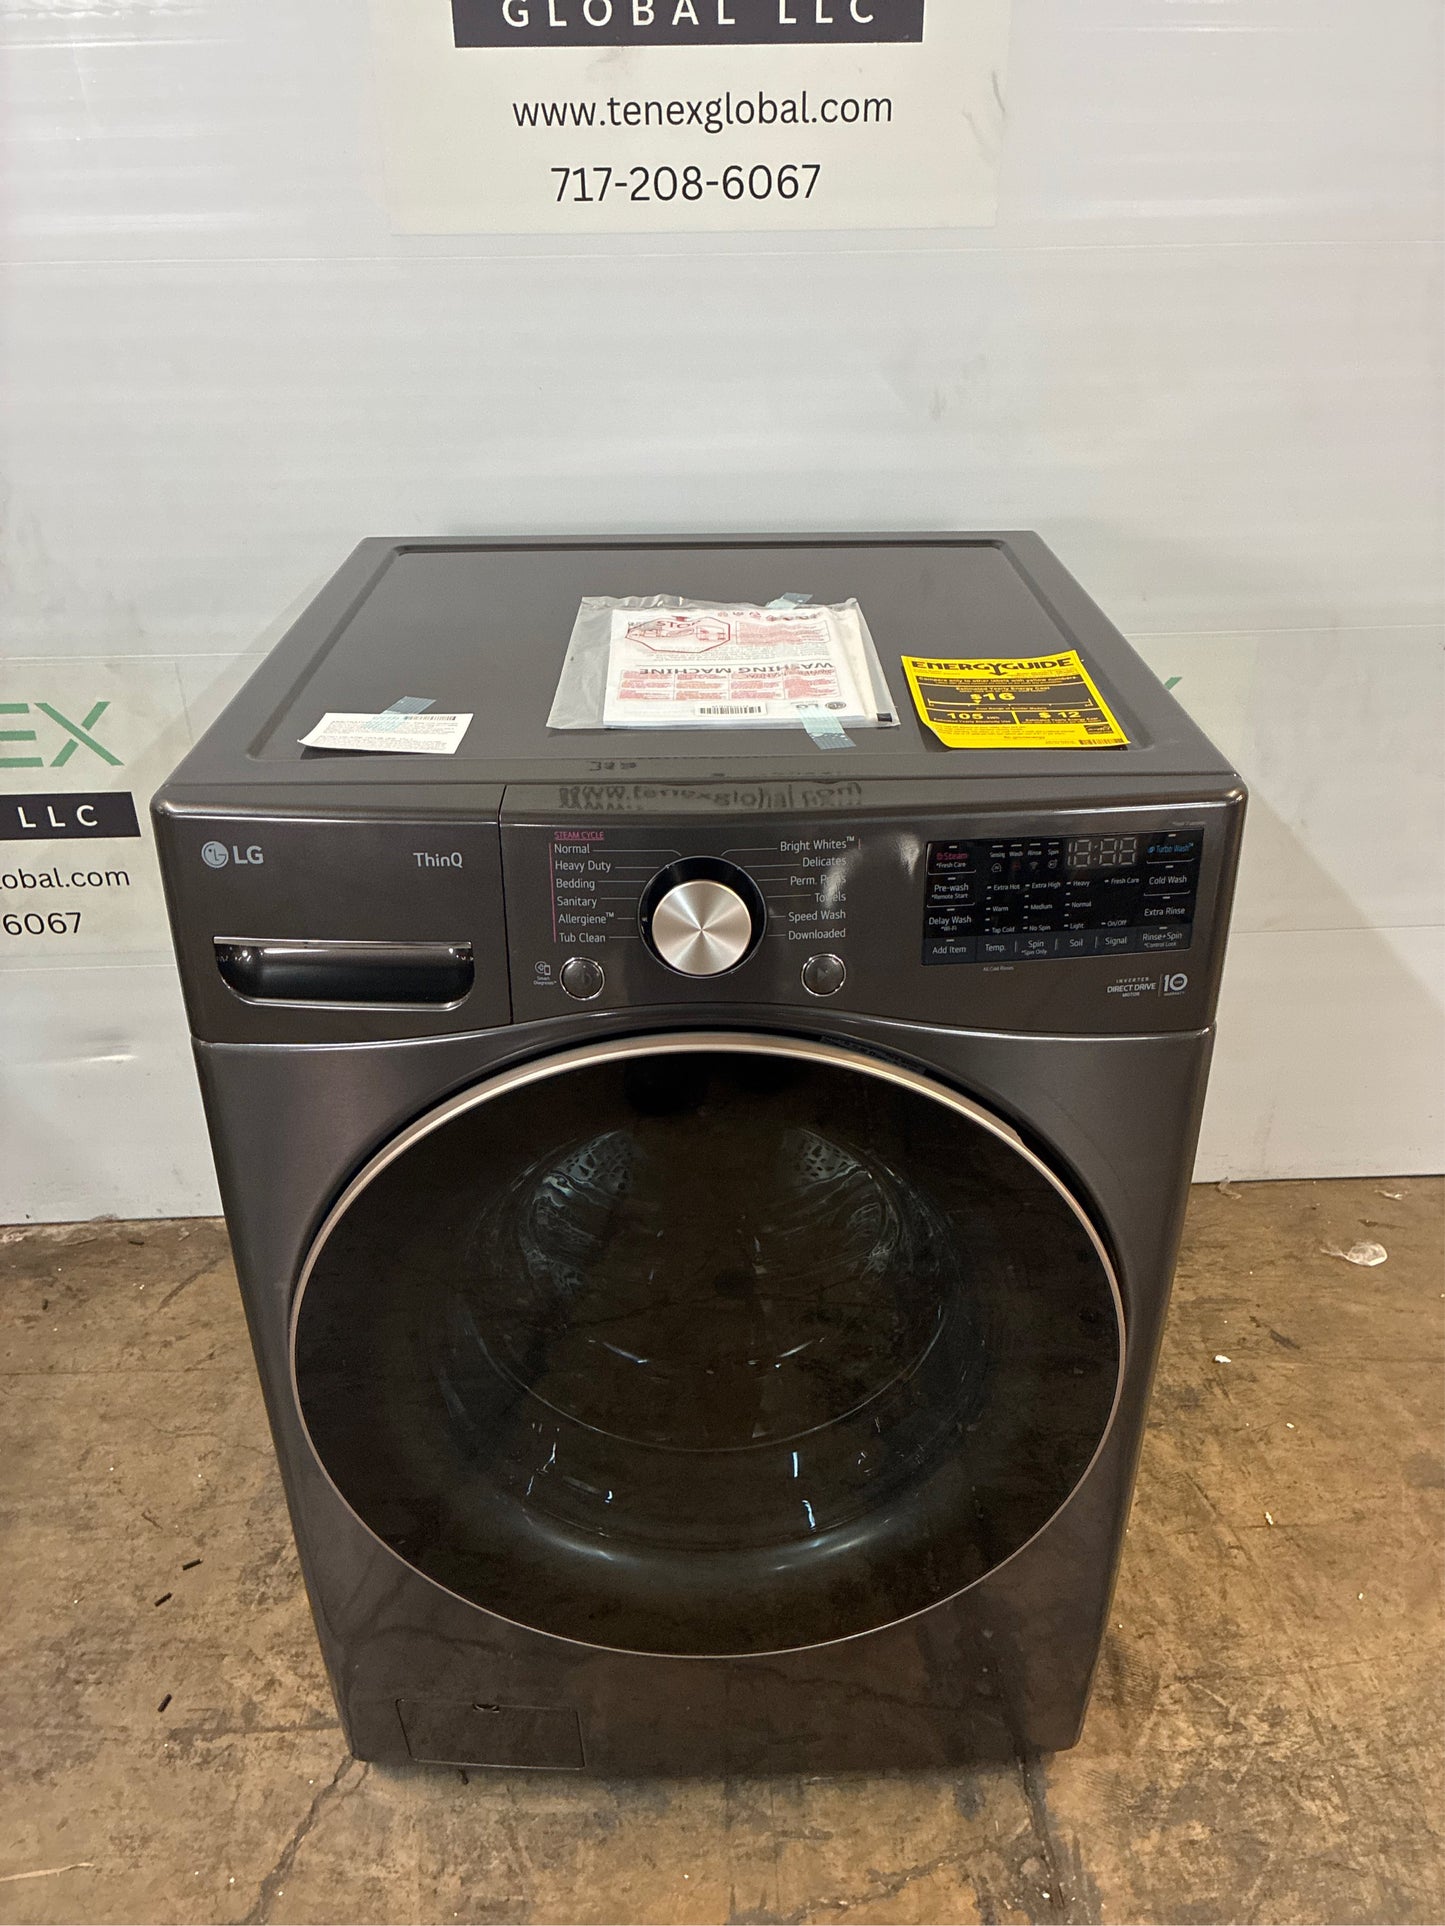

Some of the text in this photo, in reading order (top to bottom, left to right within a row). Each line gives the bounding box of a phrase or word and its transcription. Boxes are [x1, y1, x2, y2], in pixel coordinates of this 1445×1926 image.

[502, 0, 875, 26] GLOBAL LLC
[512, 91, 893, 133] www.tenexglobal.com
[550, 163, 821, 203] 717-208-6067
[911, 657, 1074, 673] ENERGYGUIDE
[947, 712, 984, 720] 105
[17, 804, 98, 828] LLC
[554, 831, 604, 840] STEAM CYCLE
[554, 843, 590, 854] Normal
[780, 839, 810, 854] Bright
[232, 845, 264, 865] LG
[412, 851, 463, 869] ThinQ
[555, 860, 612, 873] Heavy Duty
[802, 856, 847, 868] Delicates
[0, 867, 130, 889] obal.com
[790, 875, 817, 886] Perm.
[1148, 875, 1188, 885] Cold Wash
[556, 878, 595, 891] Bedding
[934, 883, 969, 892] Pre-wash
[1047, 881, 1061, 889] High
[556, 895, 598, 910] Sanitary
[814, 890, 847, 903] Toels
[788, 909, 846, 924] Speed Wash
[1144, 906, 1186, 917] Extra Rinse
[3, 911, 82, 935] 6067
[928, 915, 972, 926] Delay Wash
[1069, 922, 1085, 930] Light
[788, 927, 846, 941] Downloaded
[991, 926, 1002, 934] Tap
[1038, 924, 1051, 932] Spin
[559, 931, 606, 943] Tub Clean
[1069, 938, 1084, 947] Soil
[1104, 935, 1128, 946] Signal
[932, 946, 967, 954] Add Item
[1027, 939, 1045, 949] Spin
[1106, 982, 1157, 994] DIRECT DRIVE
